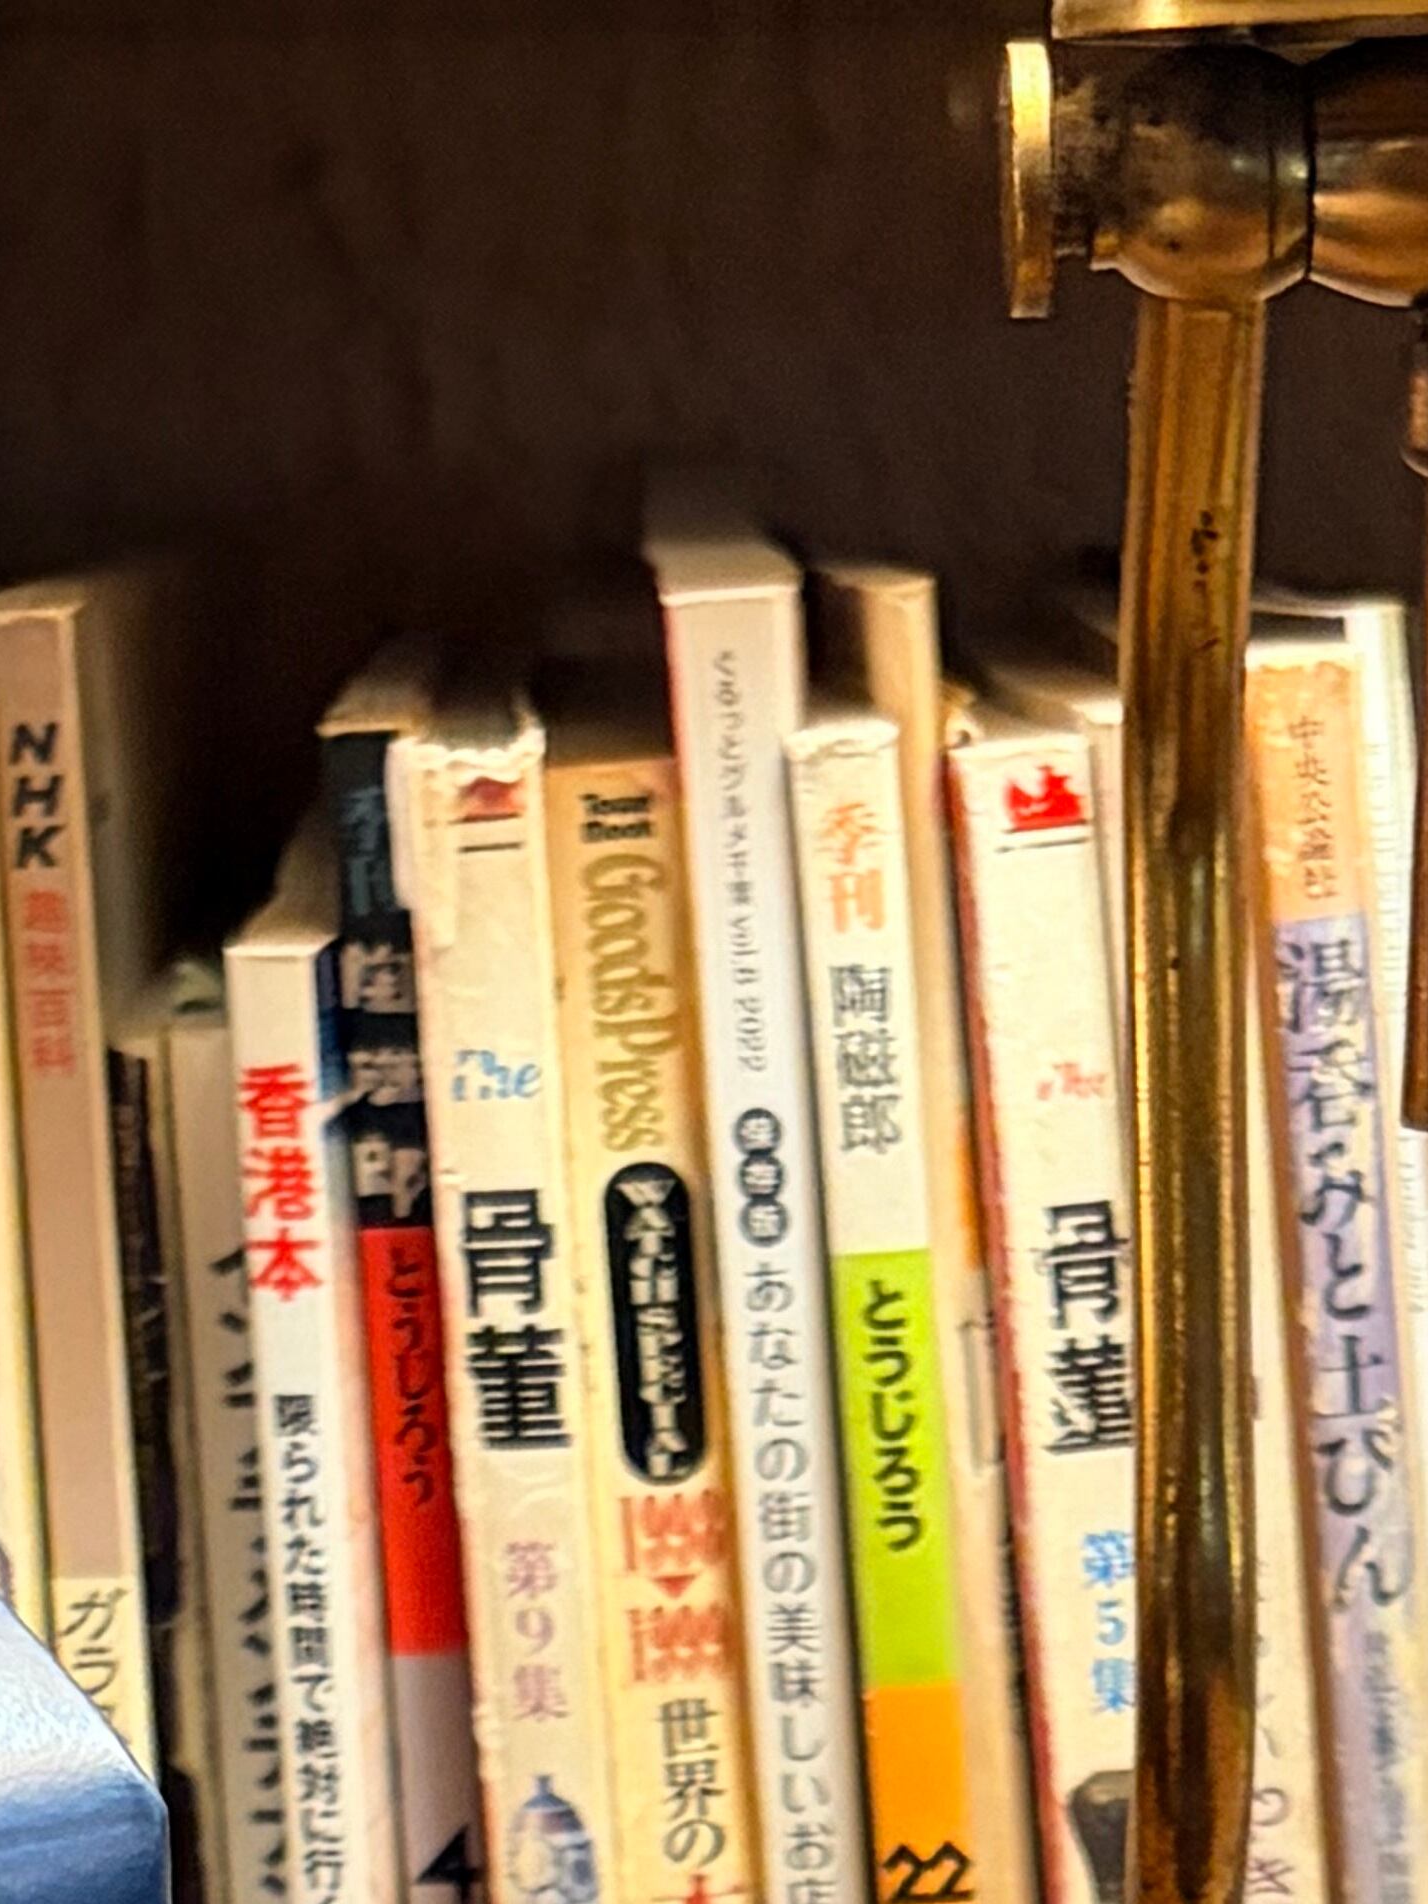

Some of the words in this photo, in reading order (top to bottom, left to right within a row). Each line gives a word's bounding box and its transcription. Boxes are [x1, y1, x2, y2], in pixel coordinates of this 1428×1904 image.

[9, 721, 66, 871] NHK
[818, 801, 888, 936] 季刊
[238, 1063, 324, 1301] 香港本
[389, 1246, 439, 1508] とうじろう
[460, 1189, 573, 1451] 骨董
[861, 1278, 923, 1554] とうじろう
[505, 1540, 569, 1722] 第9集
